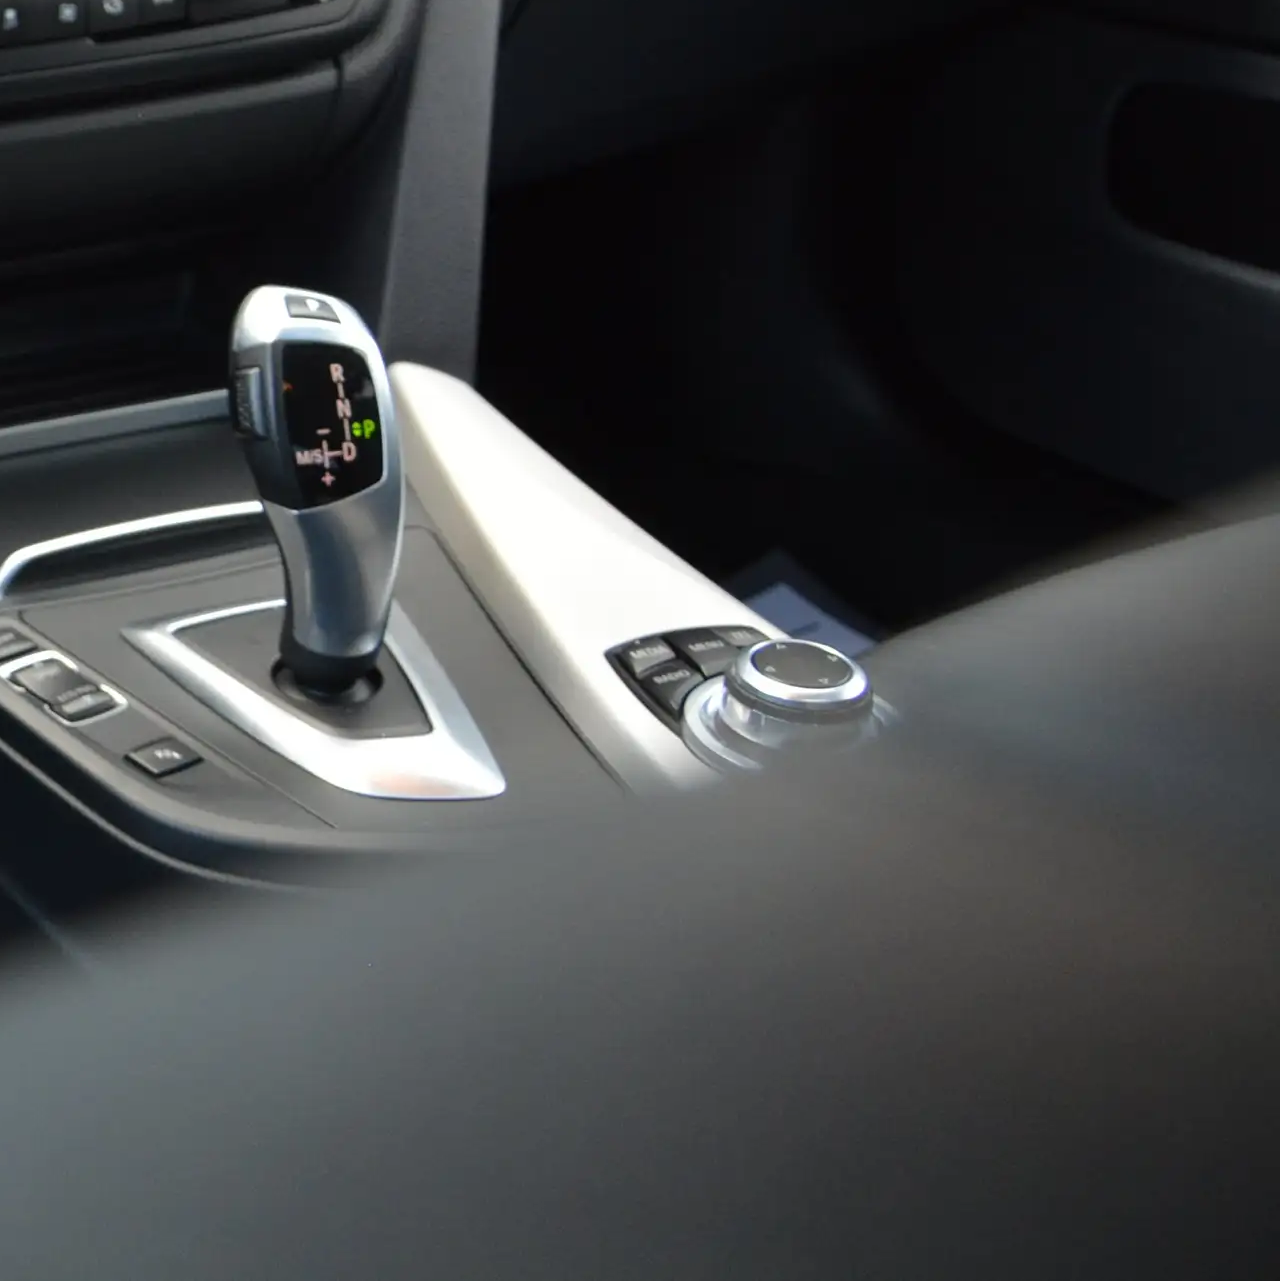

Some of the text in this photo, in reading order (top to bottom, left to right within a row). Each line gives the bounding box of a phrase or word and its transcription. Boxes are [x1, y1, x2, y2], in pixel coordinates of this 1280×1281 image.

[330, 363, 345, 382] R
[337, 399, 352, 417] N
[343, 442, 357, 461] D
[629, 645, 668, 659] MEDIA
[652, 669, 690, 684] RADIO
